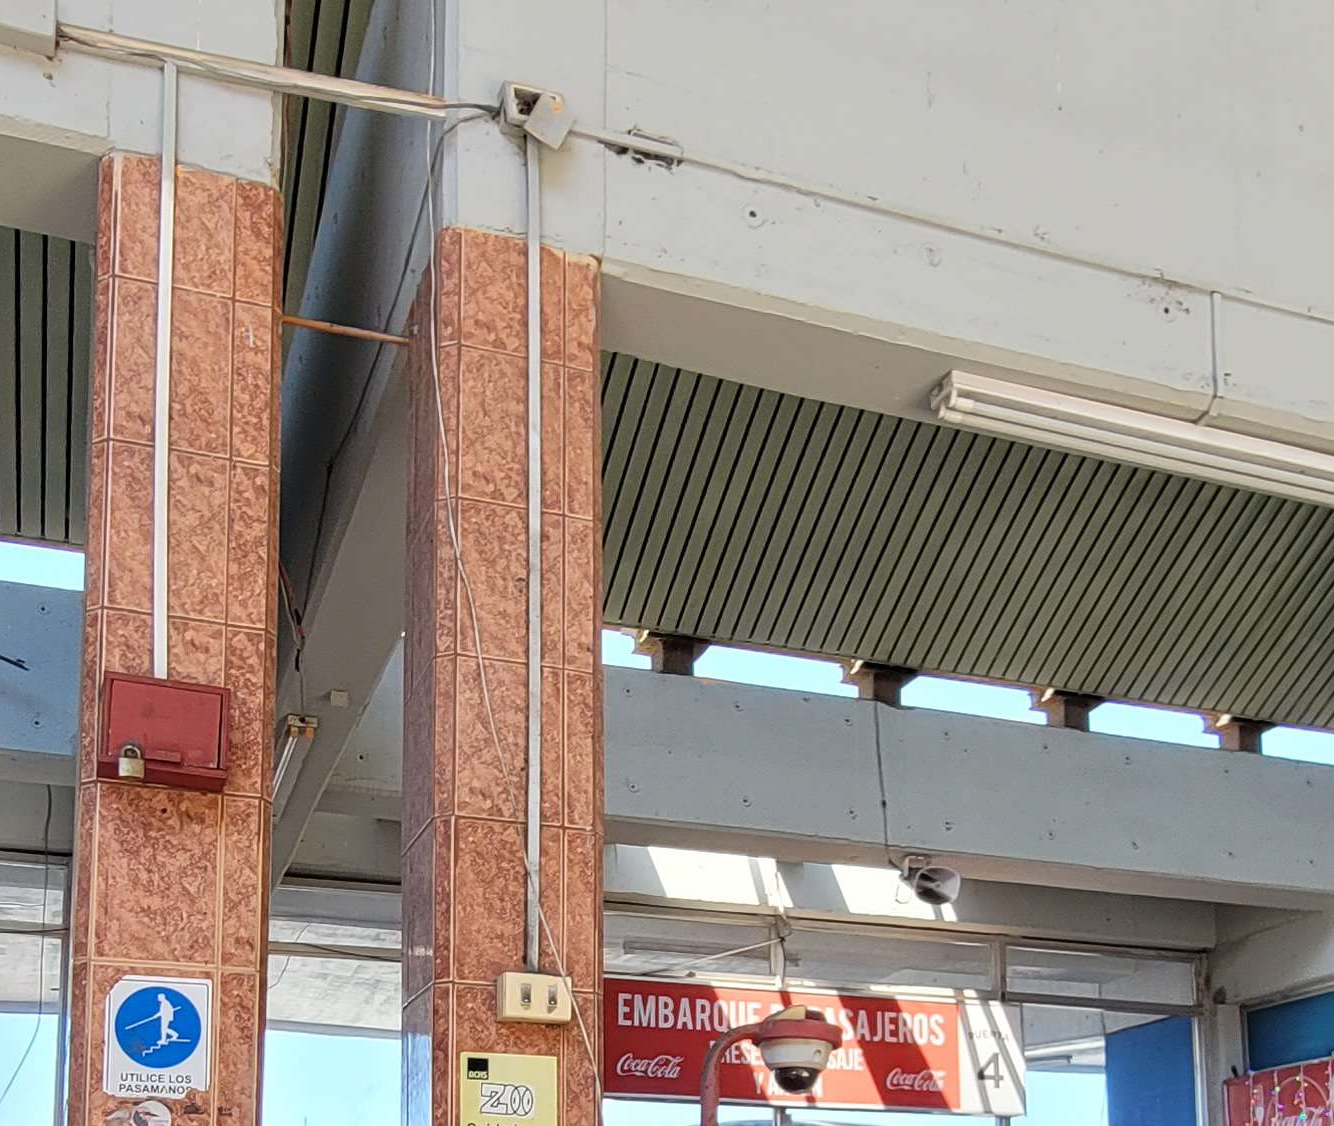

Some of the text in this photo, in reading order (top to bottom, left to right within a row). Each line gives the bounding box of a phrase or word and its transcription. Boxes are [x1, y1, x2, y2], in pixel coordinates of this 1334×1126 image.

[617, 993, 761, 1035] EMBARQUE
[120, 1072, 192, 1084] UTILICE LOS
[616, 1052, 683, 1079] Coca-Cola
[978, 1052, 1004, 1090] 4
[886, 1067, 947, 1092] Coca-Cola
